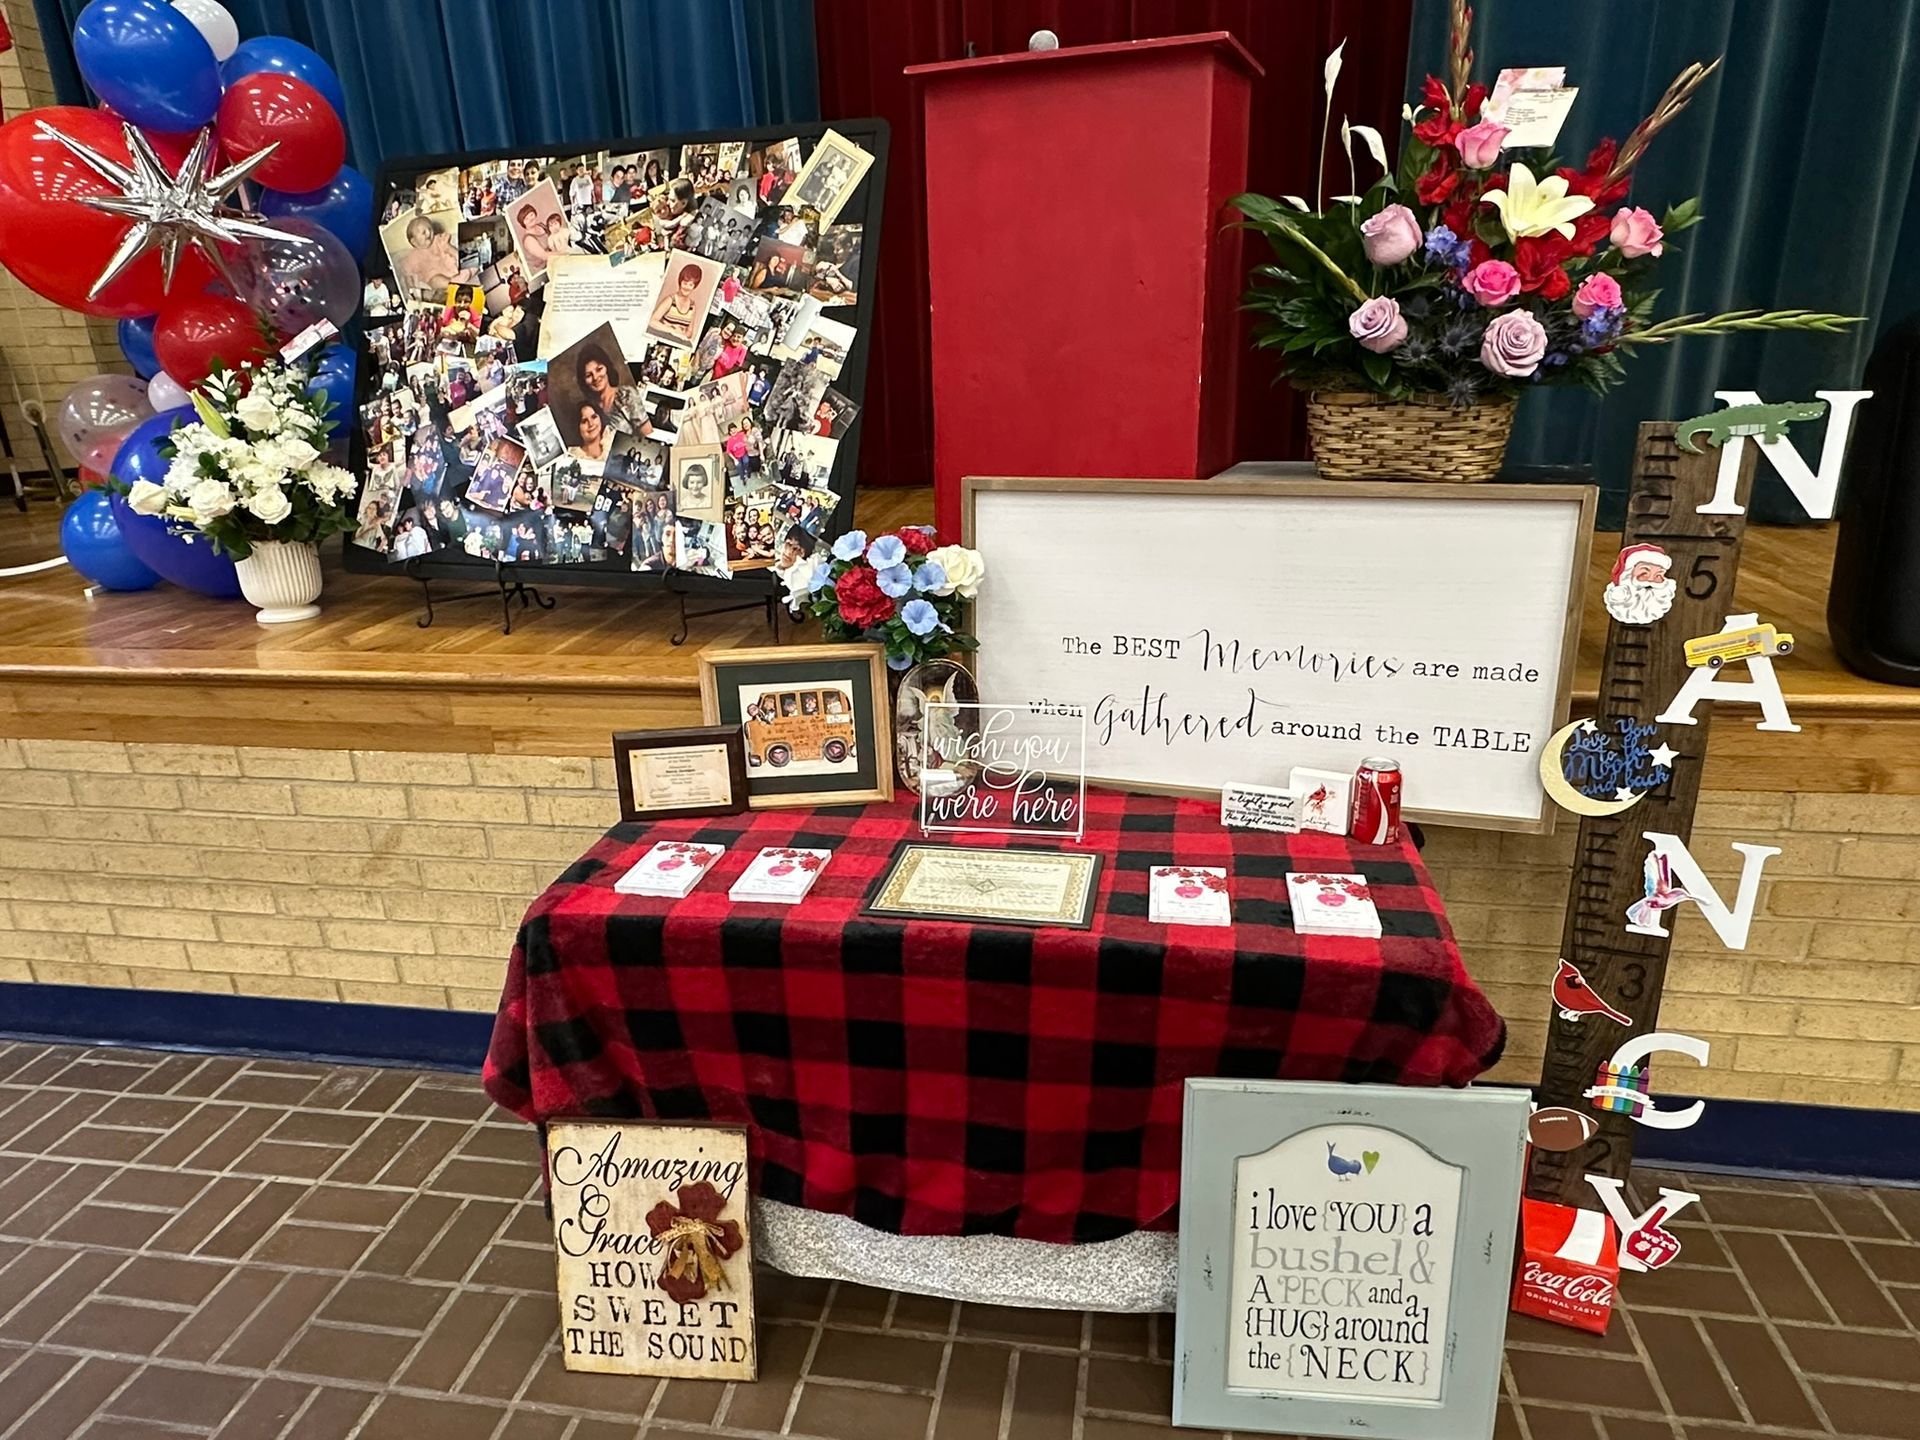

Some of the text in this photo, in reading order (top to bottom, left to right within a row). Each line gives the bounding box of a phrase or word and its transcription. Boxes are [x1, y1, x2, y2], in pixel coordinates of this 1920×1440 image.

[1685, 555, 1720, 600] 5
[1062, 629, 1539, 683] The BEST Memories are made
[1029, 684, 1531, 753] when Gathered around the TABLE
[1570, 717, 1657, 752] Love You
[933, 709, 1070, 789] wish you
[932, 769, 1078, 824] were here
[1580, 765, 1670, 795] and back
[1238, 794, 1262, 807] light
[1268, 800, 1294, 809] great
[1240, 814, 1262, 826] light
[1618, 963, 1647, 1000] 3
[553, 1131, 744, 1199] Amazing
[1583, 1138, 1611, 1173] 2
[559, 1184, 664, 1257] Grace
[1250, 1191, 1259, 1229] i
[1266, 1187, 1317, 1232] love
[1412, 1203, 1434, 1236] a
[588, 1260, 658, 1290] HOW
[1249, 1231, 1436, 1285] bushel &
[573, 1295, 738, 1328] SWEET
[1247, 1274, 1420, 1318] A PECK and a
[1526, 1291, 1570, 1309] ORIGINAL
[1572, 1304, 1602, 1316] TASTE
[1334, 1307, 1430, 1344] around
[566, 1328, 748, 1363] THE SOUND
[1248, 1341, 1281, 1370] the
